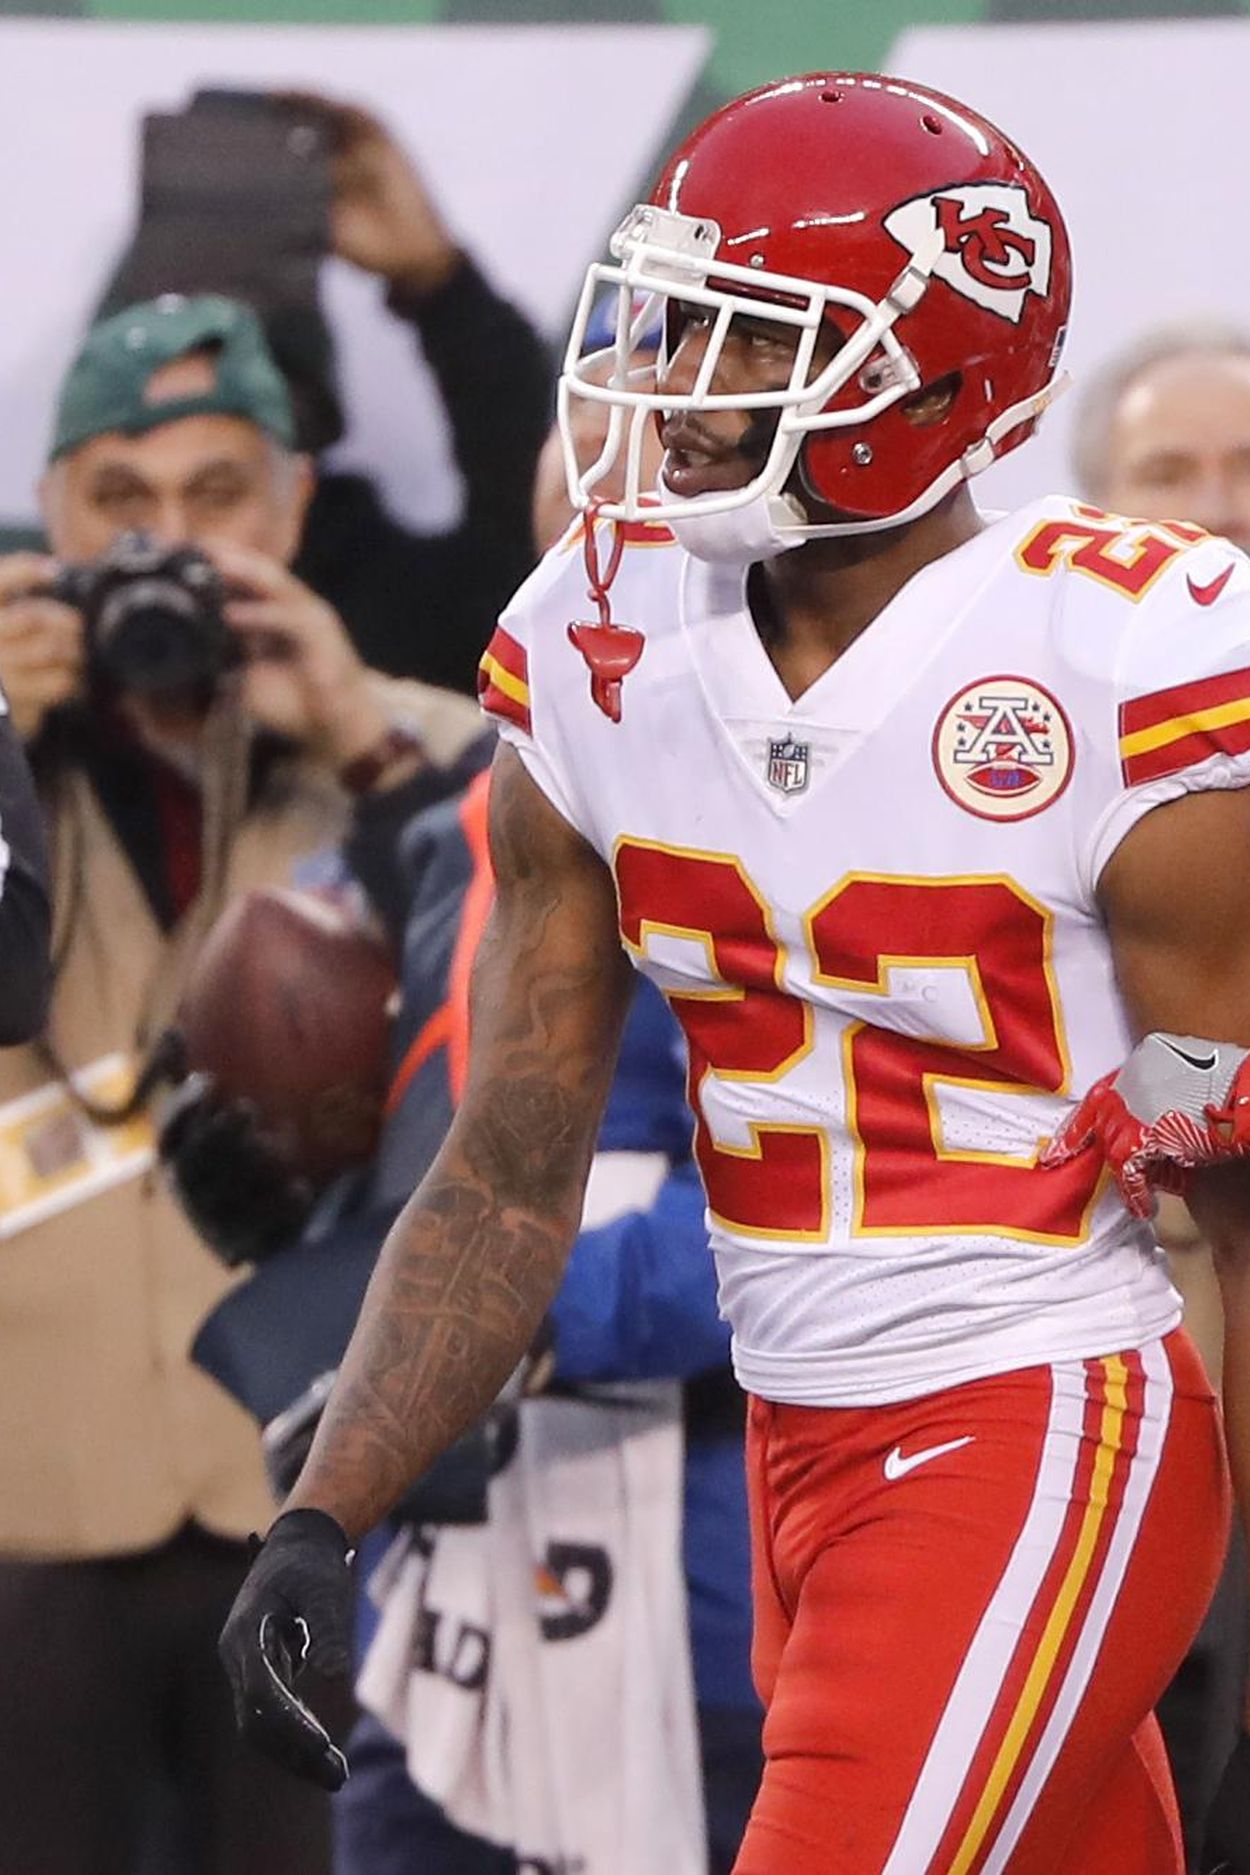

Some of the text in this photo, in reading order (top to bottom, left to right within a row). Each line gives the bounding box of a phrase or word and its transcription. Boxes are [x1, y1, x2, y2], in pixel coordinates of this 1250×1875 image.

[931, 197, 1035, 291] KC
[773, 761, 803, 787] NFL
[612, 833, 1114, 1248] 22
